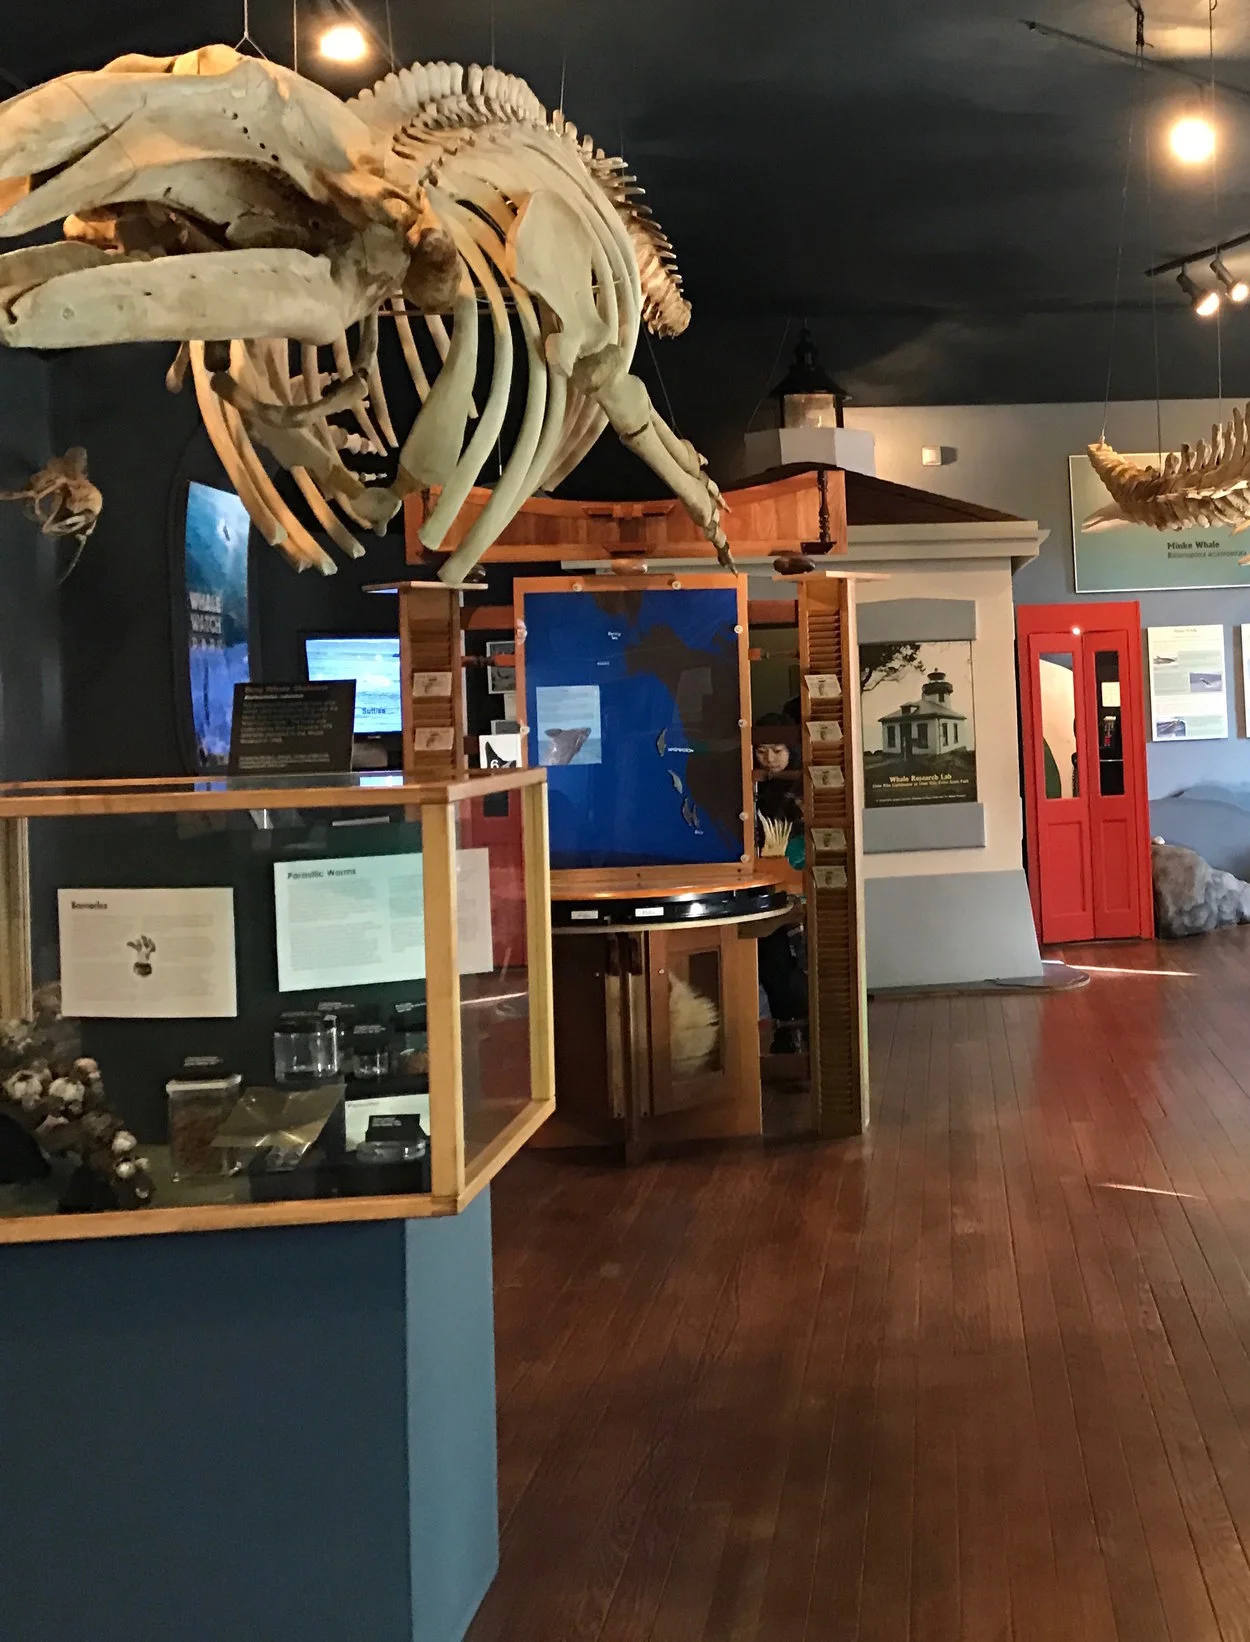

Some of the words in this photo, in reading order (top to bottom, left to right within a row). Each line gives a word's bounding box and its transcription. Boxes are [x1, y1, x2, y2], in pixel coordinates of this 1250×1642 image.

[1167, 542, 1193, 550] Minke
[1195, 541, 1220, 549] Whale
[490, 759, 500, 769] 6
[889, 775, 910, 783] Whale
[911, 774, 939, 782] Research
[327, 868, 356, 877] Worms
